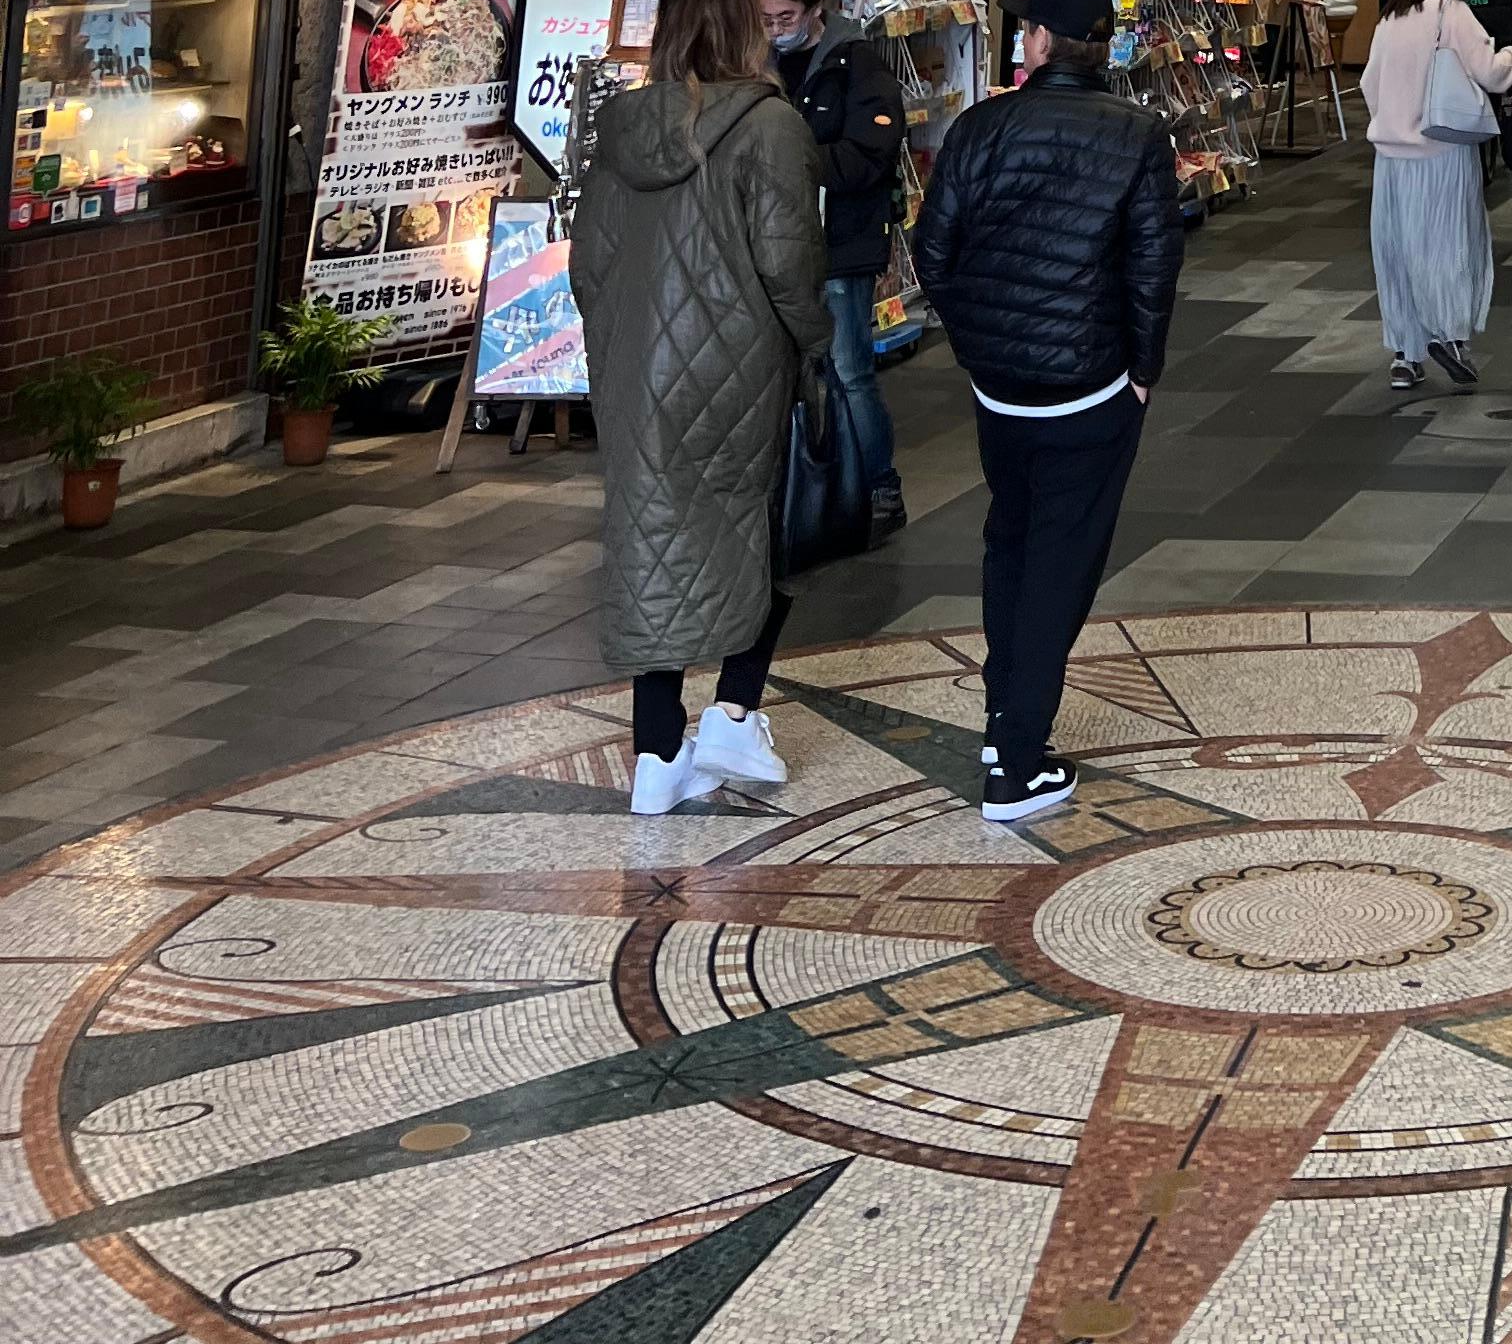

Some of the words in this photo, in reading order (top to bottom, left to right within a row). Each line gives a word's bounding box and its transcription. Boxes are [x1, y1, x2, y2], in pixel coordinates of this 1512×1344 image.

[347, 95, 425, 117] ヤングメン
[429, 90, 471, 110] ランチ
